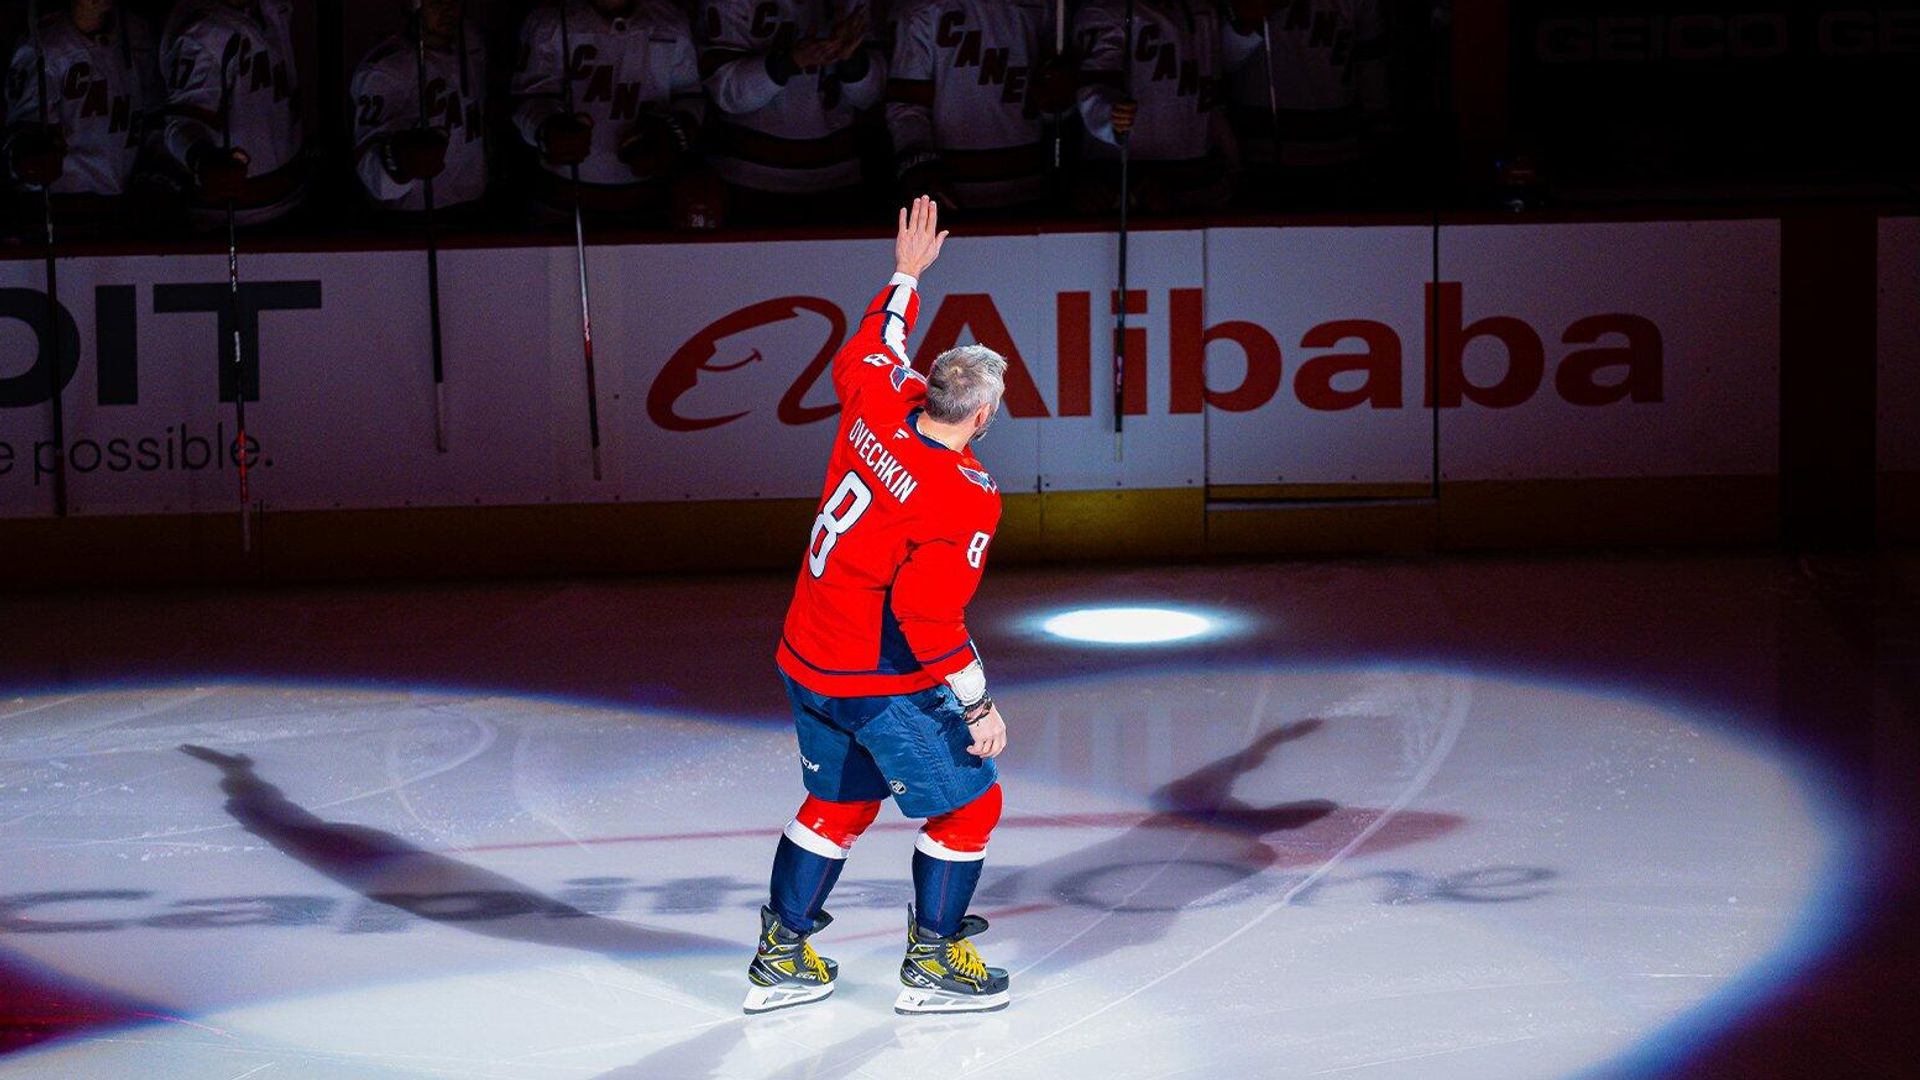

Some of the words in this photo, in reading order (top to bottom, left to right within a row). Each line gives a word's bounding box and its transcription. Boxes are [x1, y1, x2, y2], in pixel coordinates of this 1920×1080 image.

[1536, 13, 1789, 63] GEICO
[908, 281, 1663, 418] Alibaba
[34, 422, 273, 485] possible.
[849, 417, 918, 504] OVECHKIN
[808, 469, 874, 579] 8
[966, 531, 990, 569] 8
